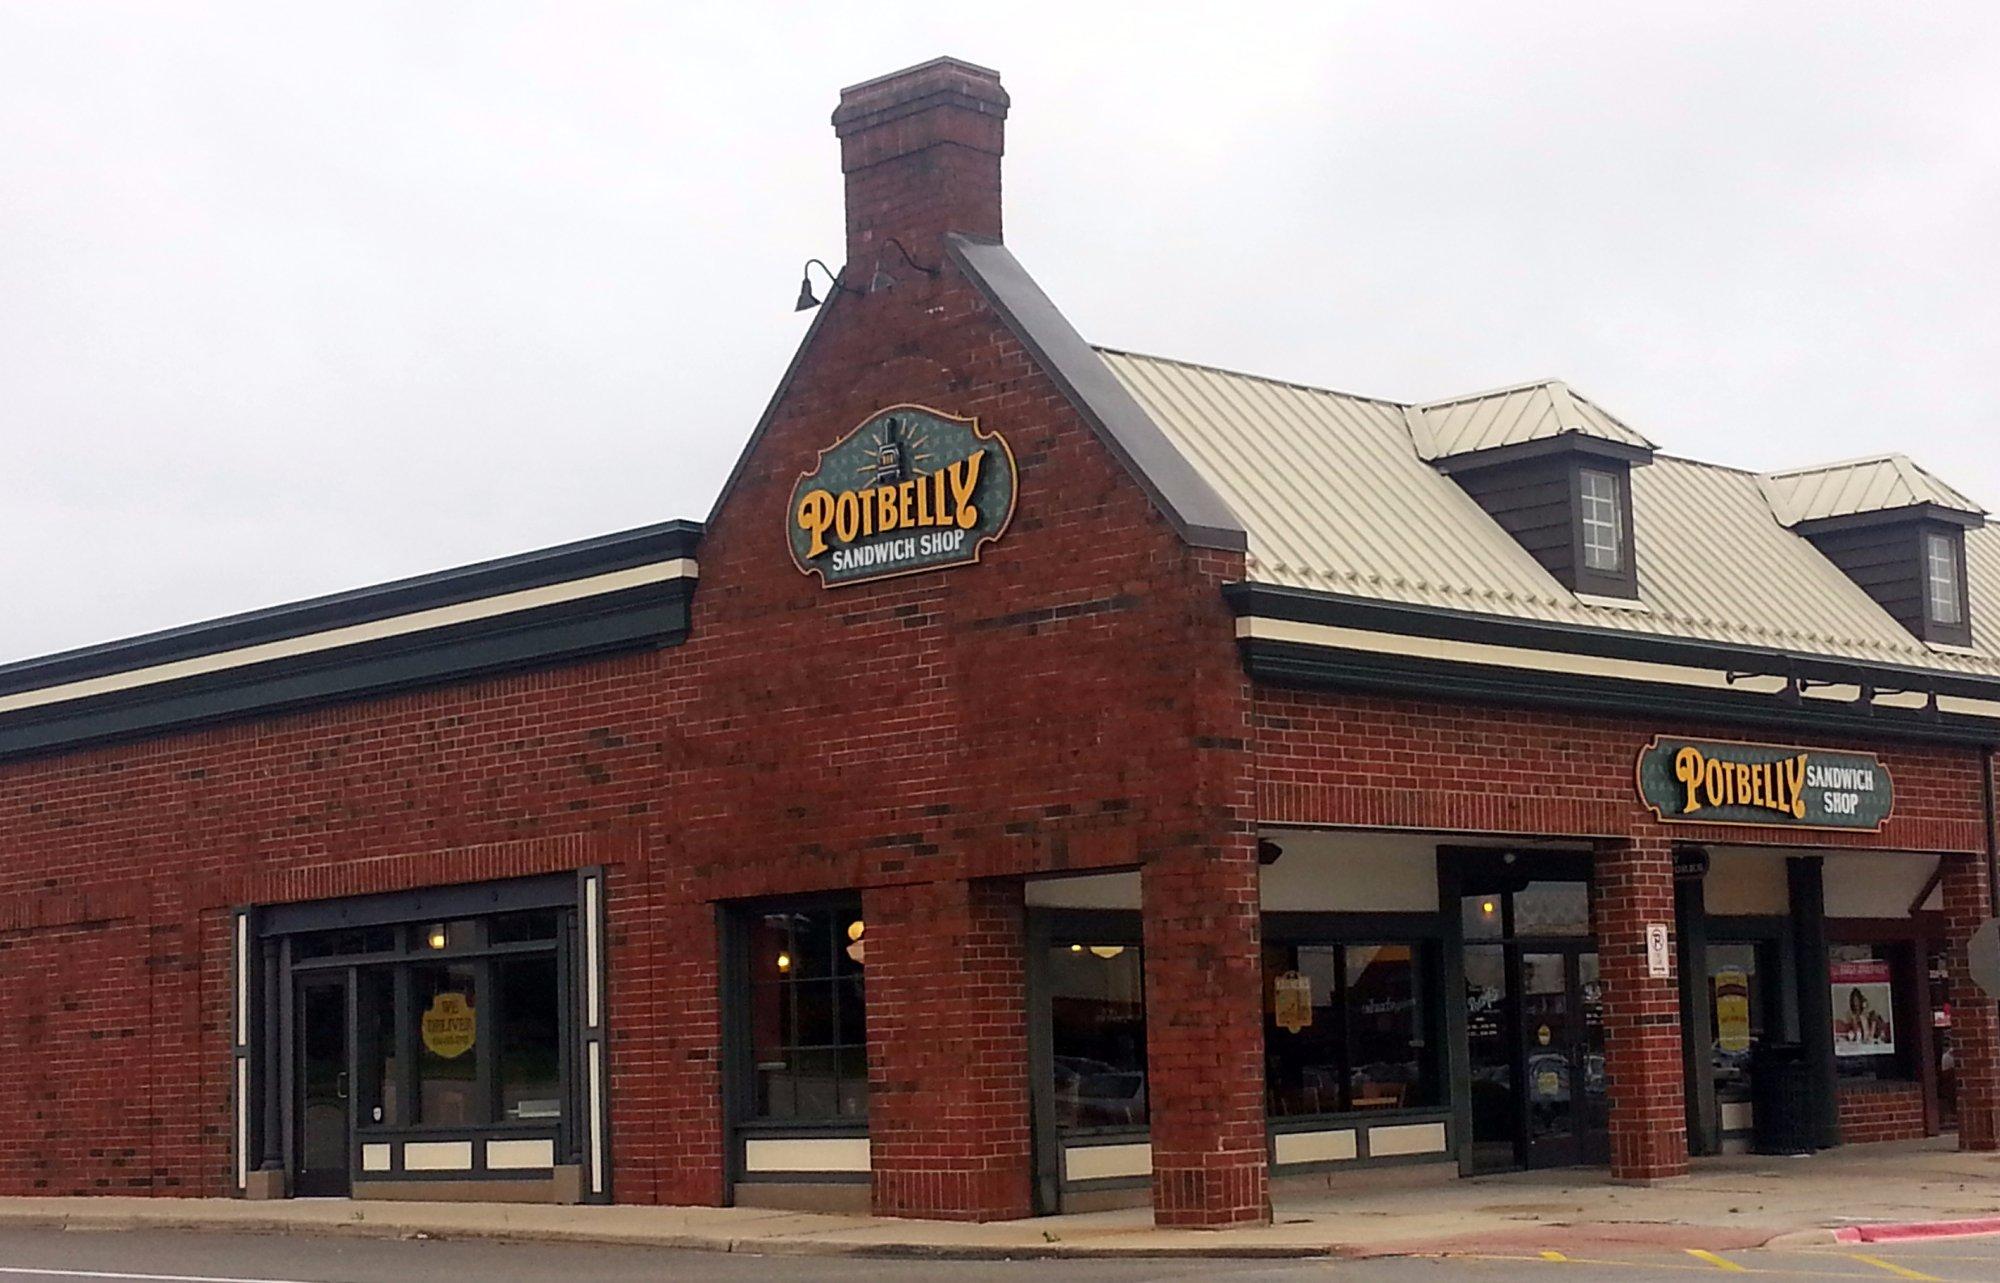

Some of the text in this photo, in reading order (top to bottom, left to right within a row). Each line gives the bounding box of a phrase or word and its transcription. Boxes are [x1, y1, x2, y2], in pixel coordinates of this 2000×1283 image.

[798, 449, 985, 559] POTBELLY
[832, 528, 965, 571] SANDWICH SHOP
[1675, 746, 1808, 819] POTBELLY
[1807, 765, 1874, 791] SANDWICH
[1823, 792, 1859, 815] SHOP
